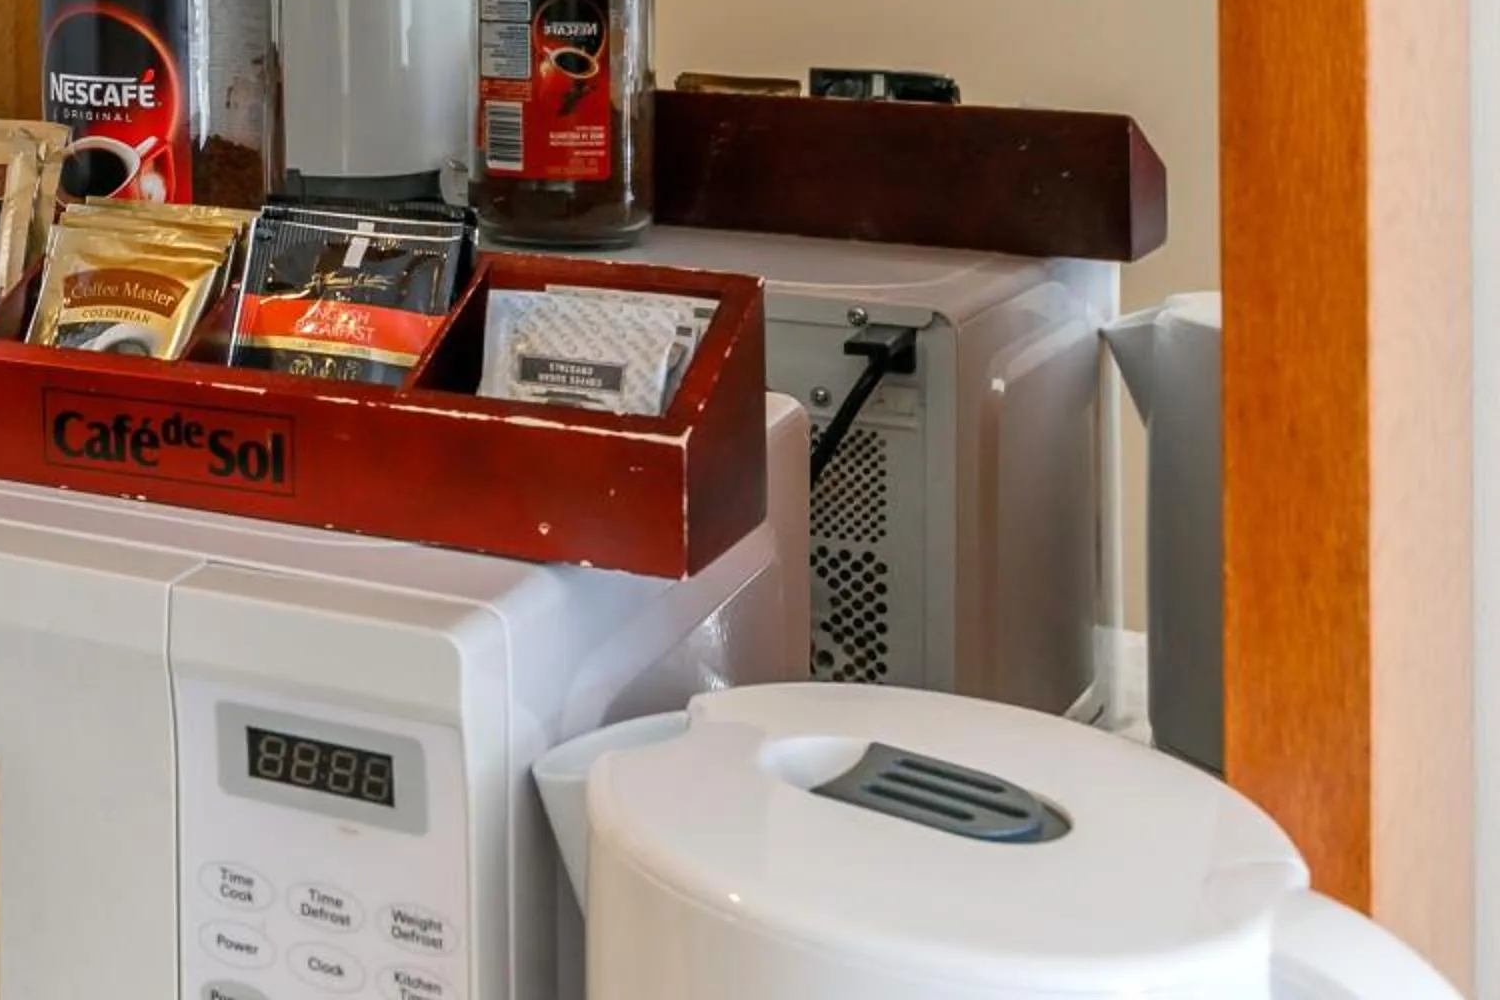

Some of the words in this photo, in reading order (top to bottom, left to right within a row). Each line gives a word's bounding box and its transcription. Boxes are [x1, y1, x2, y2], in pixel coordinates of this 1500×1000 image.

[49, 69, 156, 108] NESCAFÉ
[63, 108, 133, 123] ORIGINAL
[71, 281, 120, 298] Coffee
[124, 281, 176, 307] Master
[82, 307, 150, 324] COLOMBIAN
[53, 410, 160, 467] Café
[161, 411, 205, 448] de
[207, 429, 286, 484] Sol
[220, 866, 254, 887] Time
[220, 883, 253, 902] Cook
[308, 888, 343, 908] Time
[301, 903, 351, 927] Defrost
[391, 908, 443, 933] Weight
[216, 933, 259, 955] Power
[391, 926, 443, 950] Defrost
[307, 956, 344, 976] Clock
[394, 971, 443, 996] Kitchen
